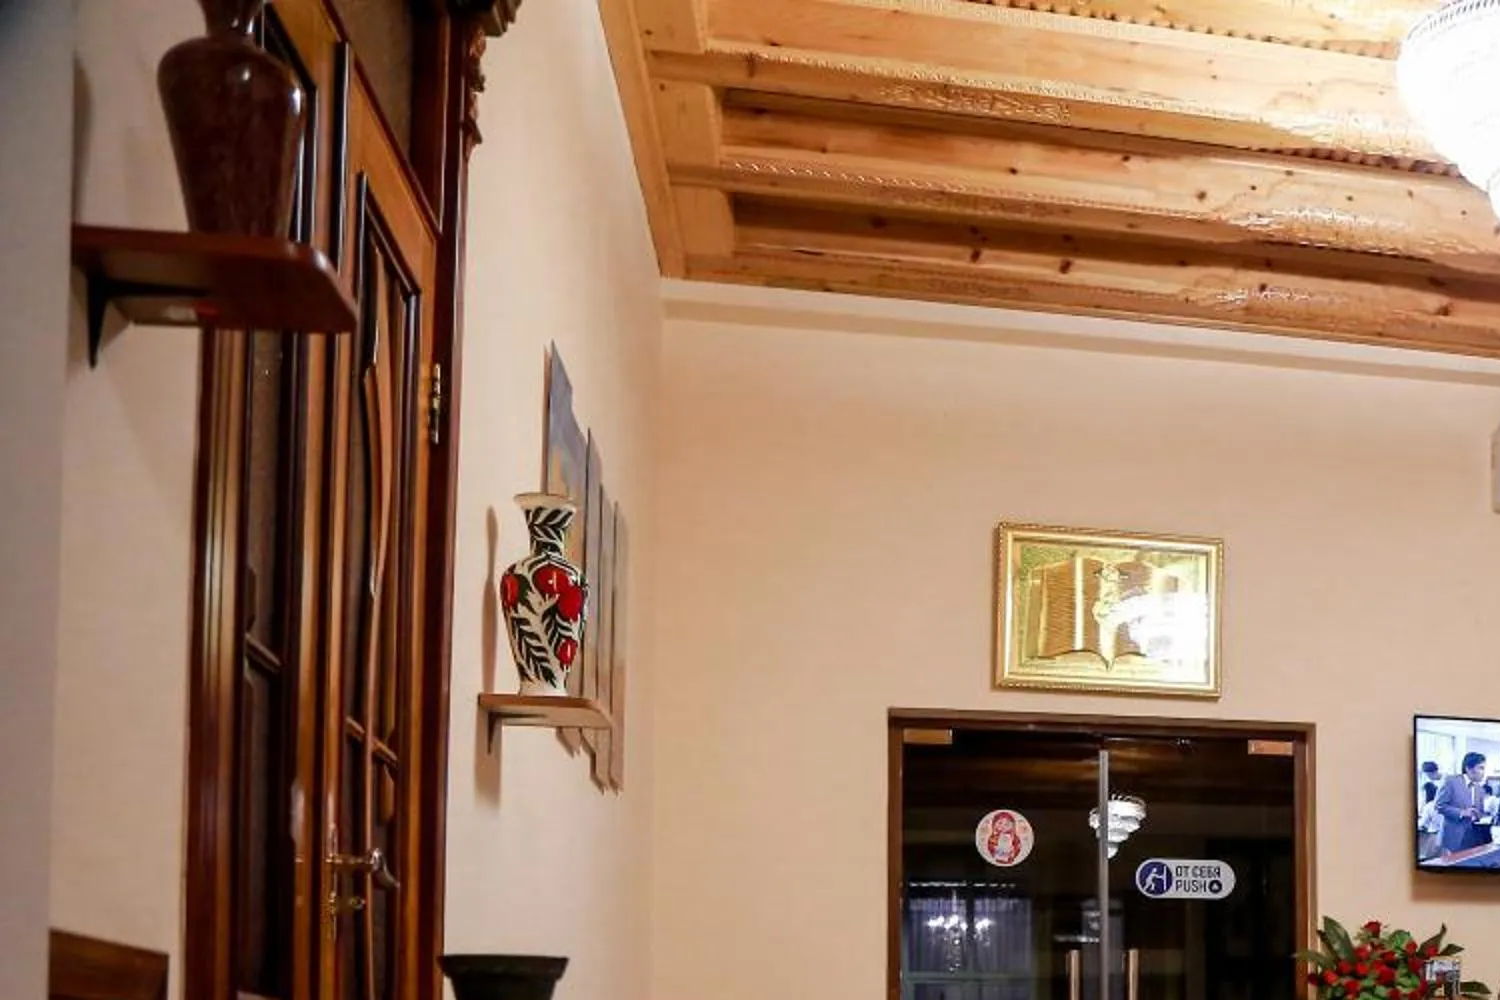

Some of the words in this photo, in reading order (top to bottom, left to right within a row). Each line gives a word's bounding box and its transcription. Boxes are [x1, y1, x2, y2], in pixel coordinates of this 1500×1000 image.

[1175, 865, 1190, 877] ОТ
[1191, 866, 1221, 879] СЕБЯ
[1175, 879, 1207, 893] PUSH
